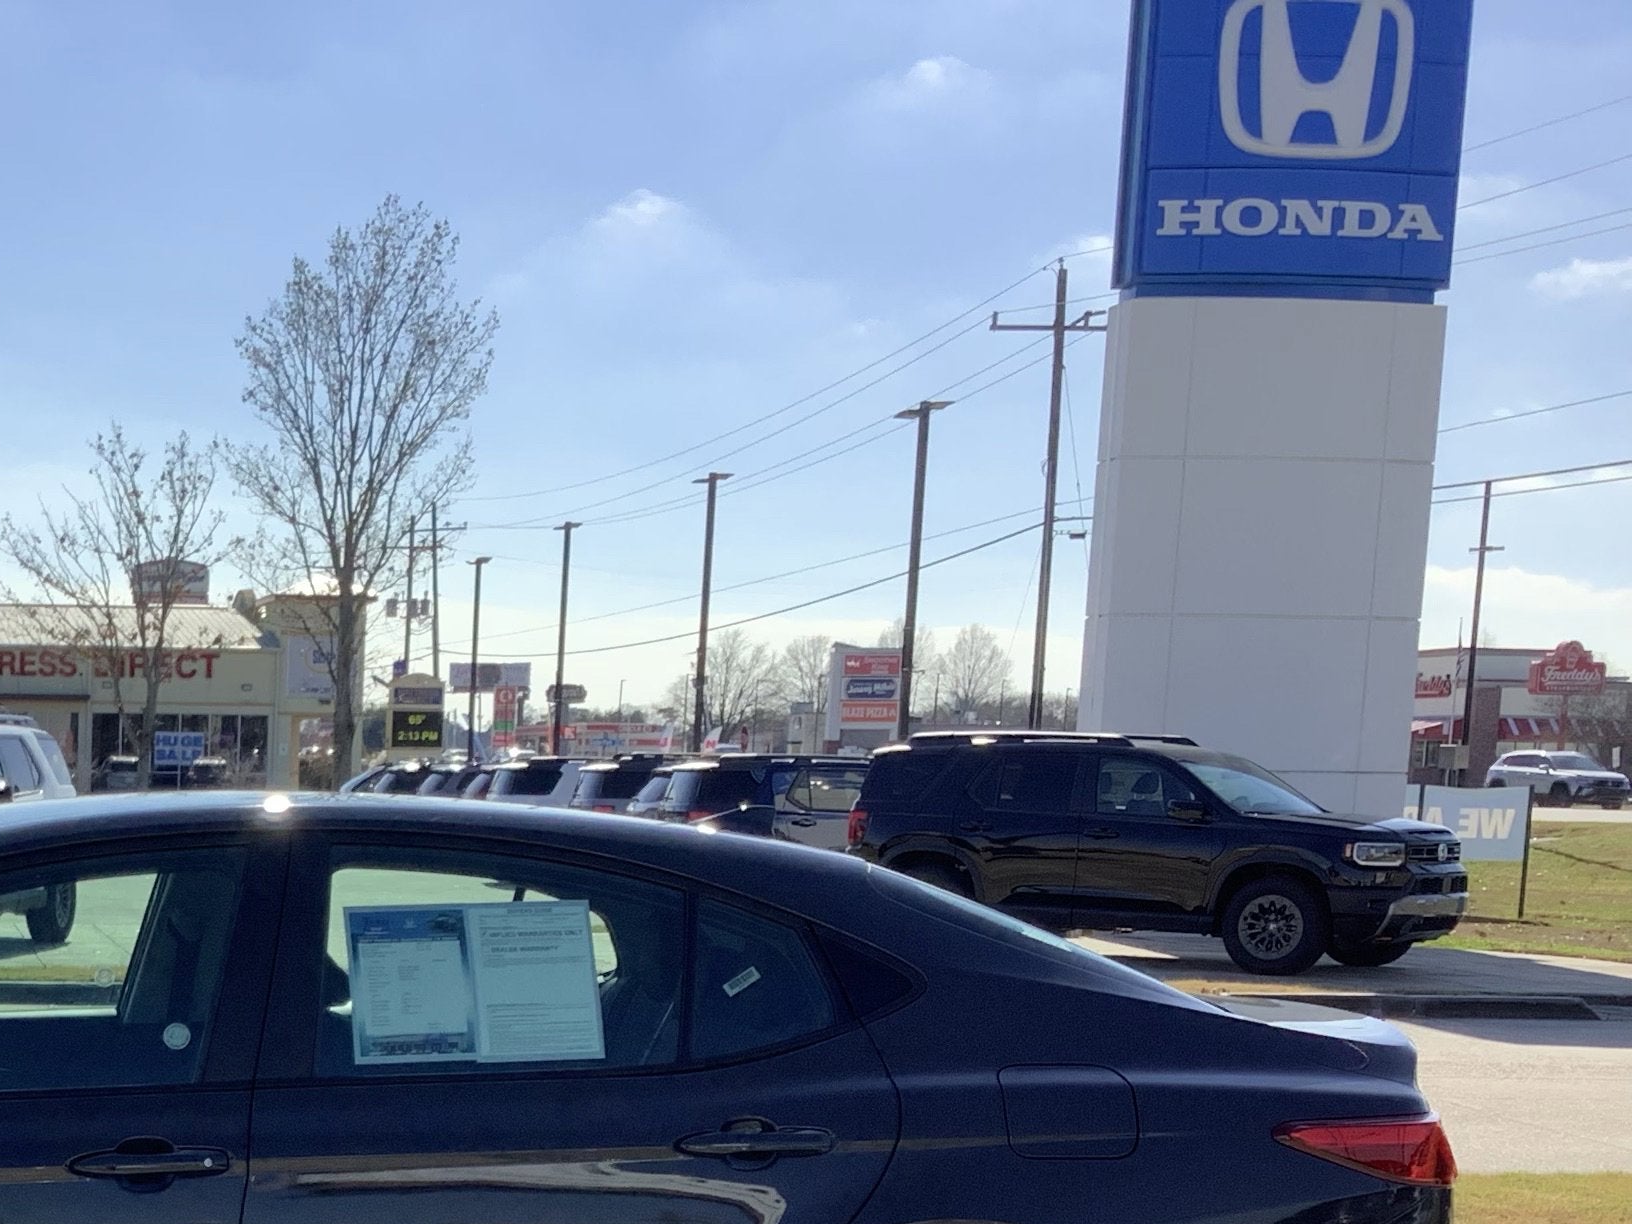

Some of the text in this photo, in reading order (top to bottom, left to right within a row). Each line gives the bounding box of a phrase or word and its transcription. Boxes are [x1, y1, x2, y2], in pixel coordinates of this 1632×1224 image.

[1155, 198, 1444, 242] HONDA
[1541, 666, 1601, 683] Freddy's
[155, 734, 204, 748] HUGE
[421, 730, 439, 742] PM
